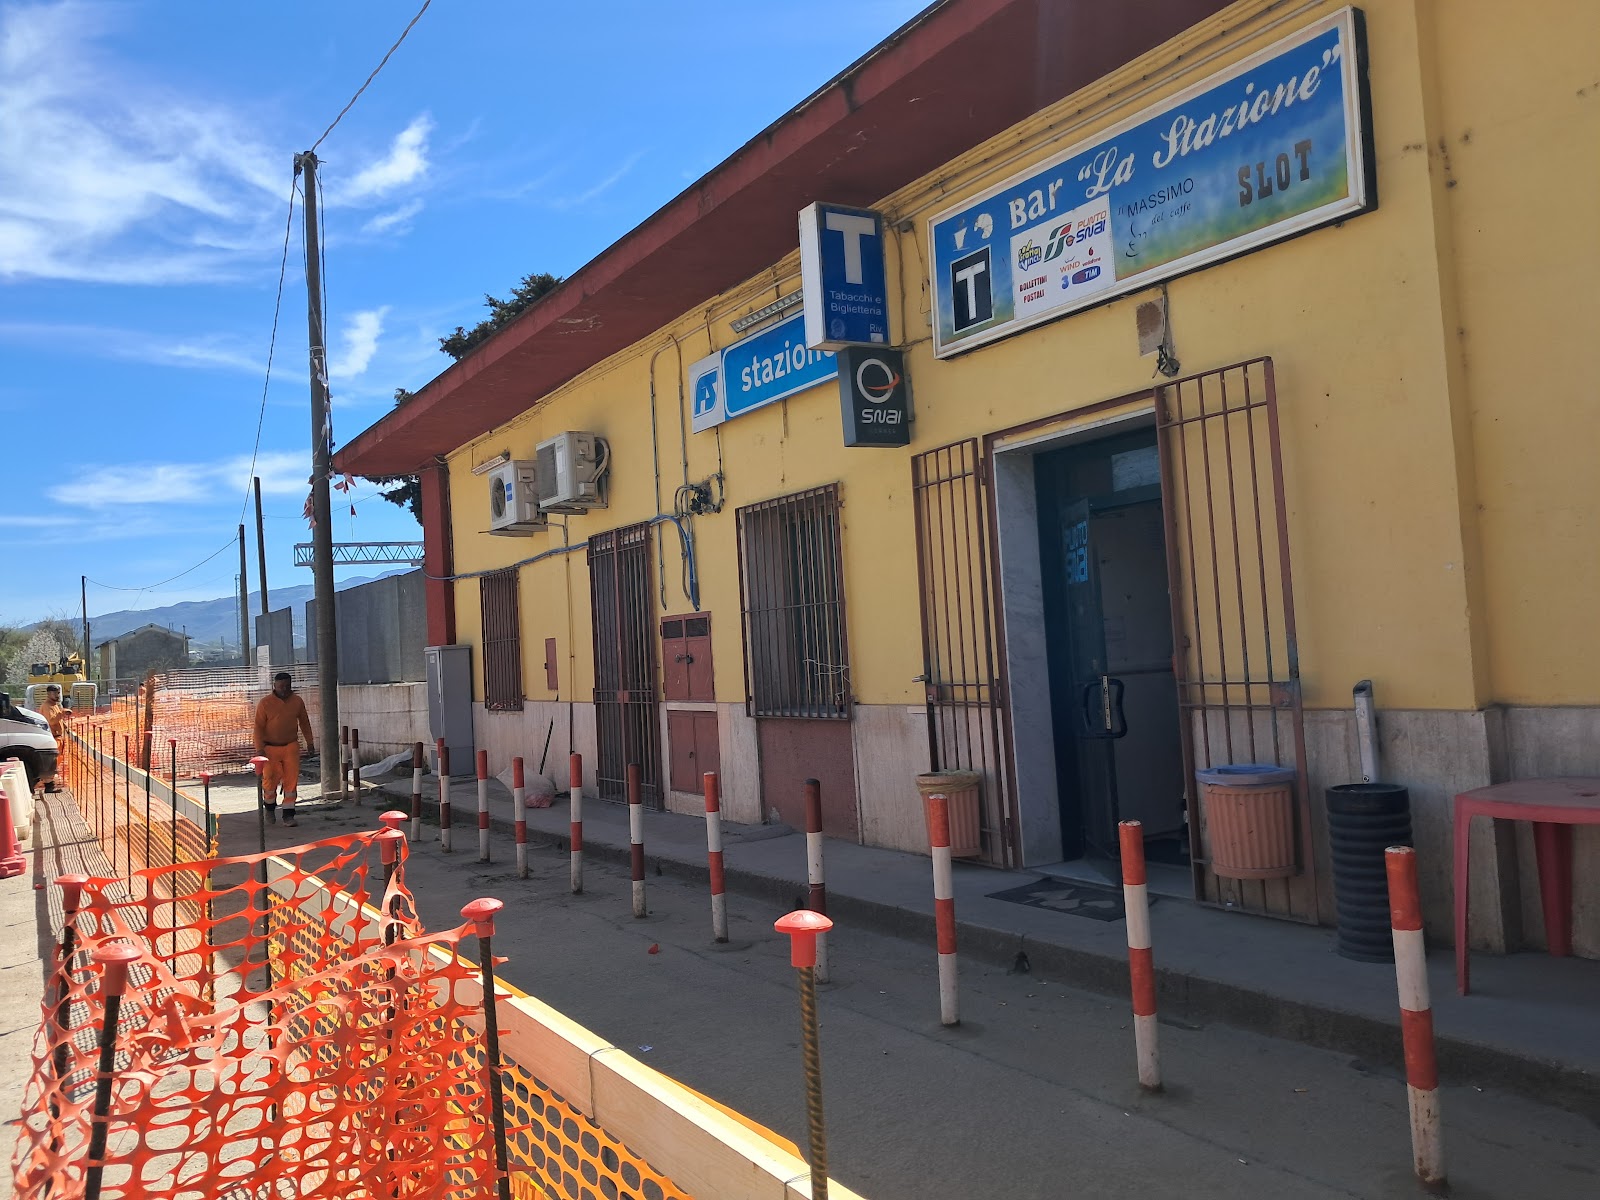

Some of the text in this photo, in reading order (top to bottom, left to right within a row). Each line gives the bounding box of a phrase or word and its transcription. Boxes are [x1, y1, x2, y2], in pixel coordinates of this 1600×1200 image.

[1238, 139, 1312, 207] SLOT
[1008, 178, 1063, 230] Bar
[1127, 178, 1194, 217] MASSIMO
[1077, 210, 1107, 229] PUNTO
[826, 212, 875, 285] T
[1059, 260, 1081, 273] WIND
[1085, 267, 1098, 279] TIM
[830, 291, 882, 304] Tabacchi e
[955, 260, 986, 320] T
[1023, 289, 1045, 304] POSTALI
[831, 303, 882, 316] Biglietteria
